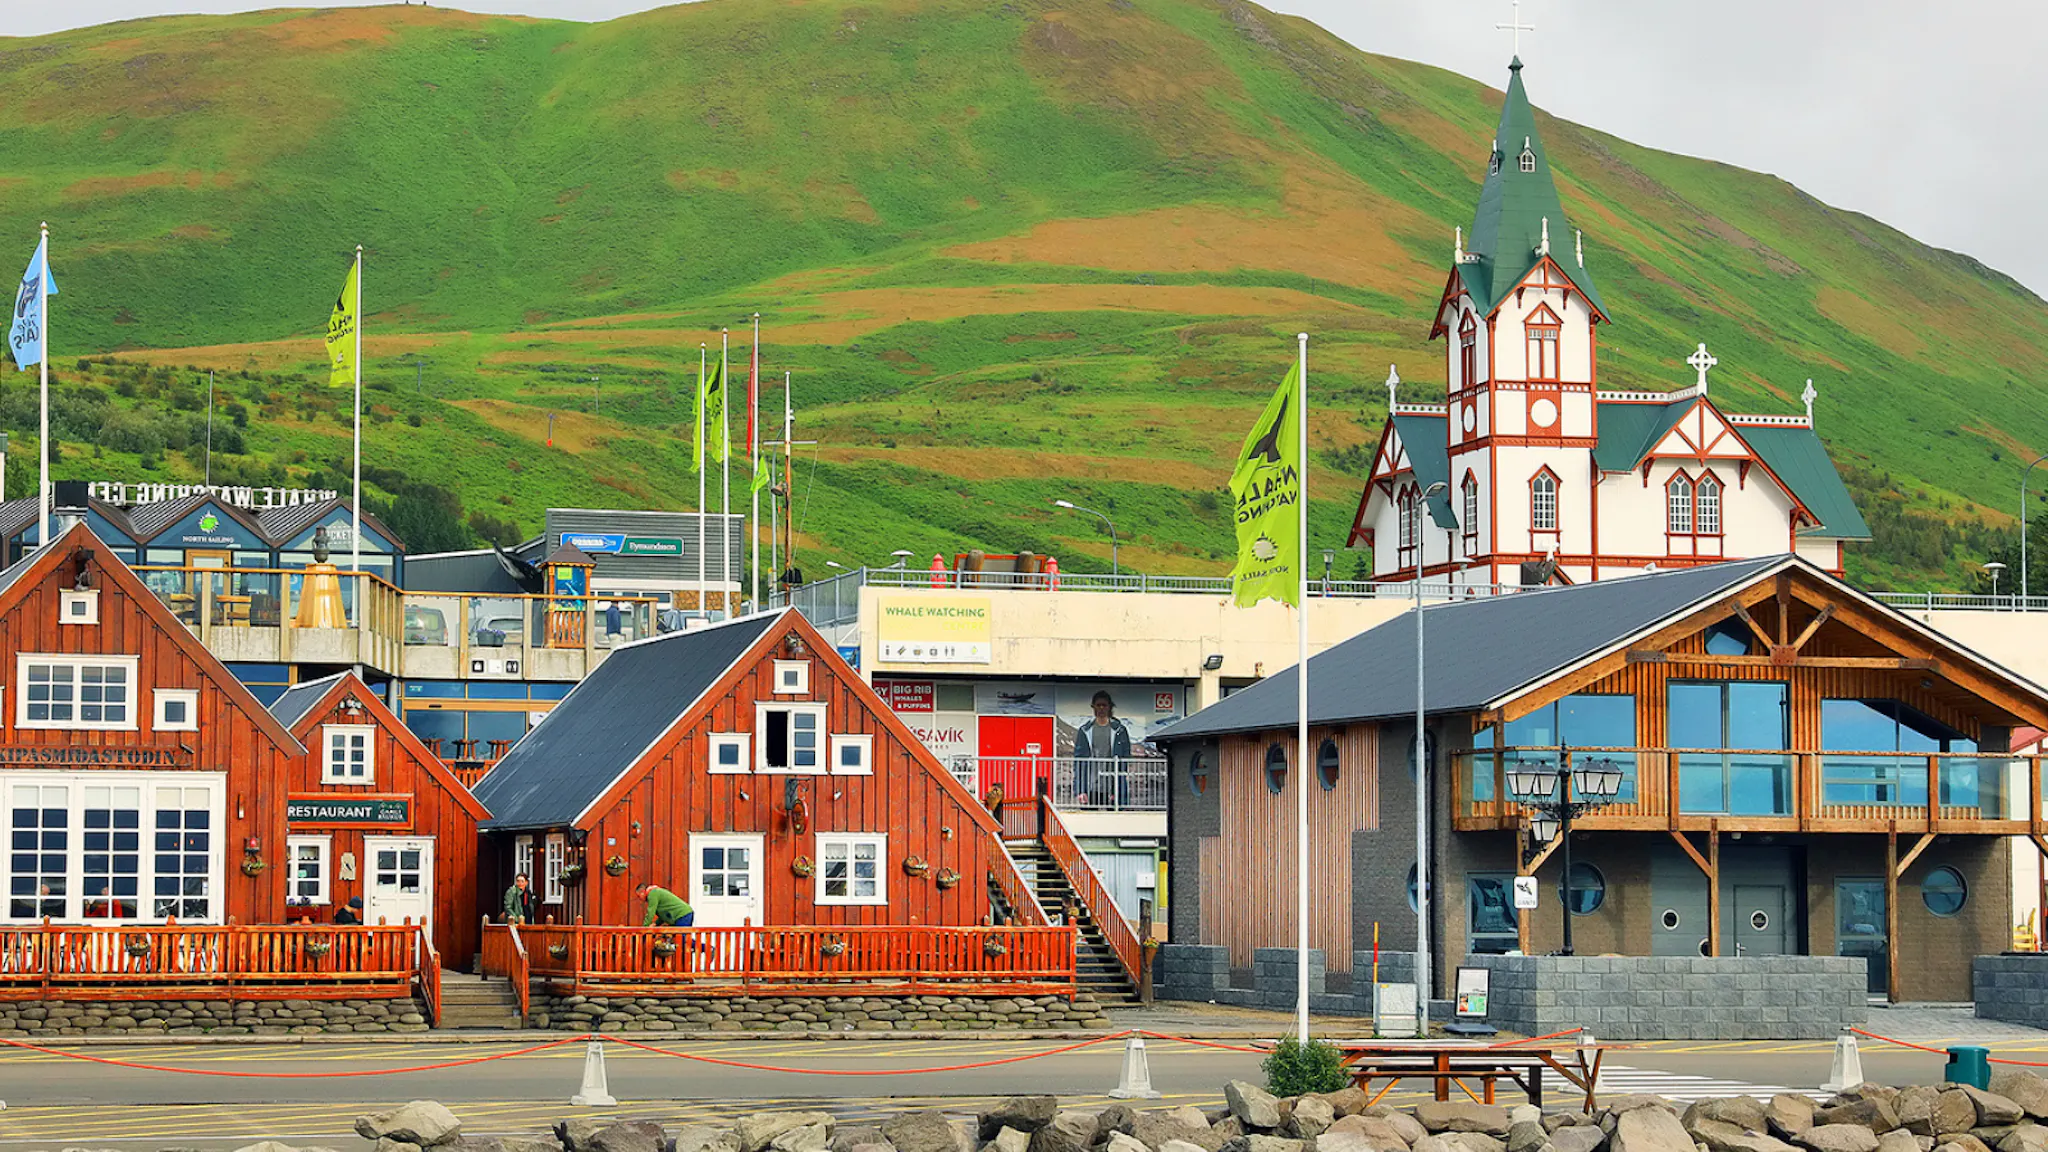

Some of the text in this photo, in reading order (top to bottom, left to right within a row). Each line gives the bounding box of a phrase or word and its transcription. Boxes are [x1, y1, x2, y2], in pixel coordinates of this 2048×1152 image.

[886, 607, 985, 617] WHALE WATCHING
[893, 685, 932, 694] BIG RIB
[1156, 694, 1171, 708] 66
[288, 806, 372, 817] RESTAURANT
